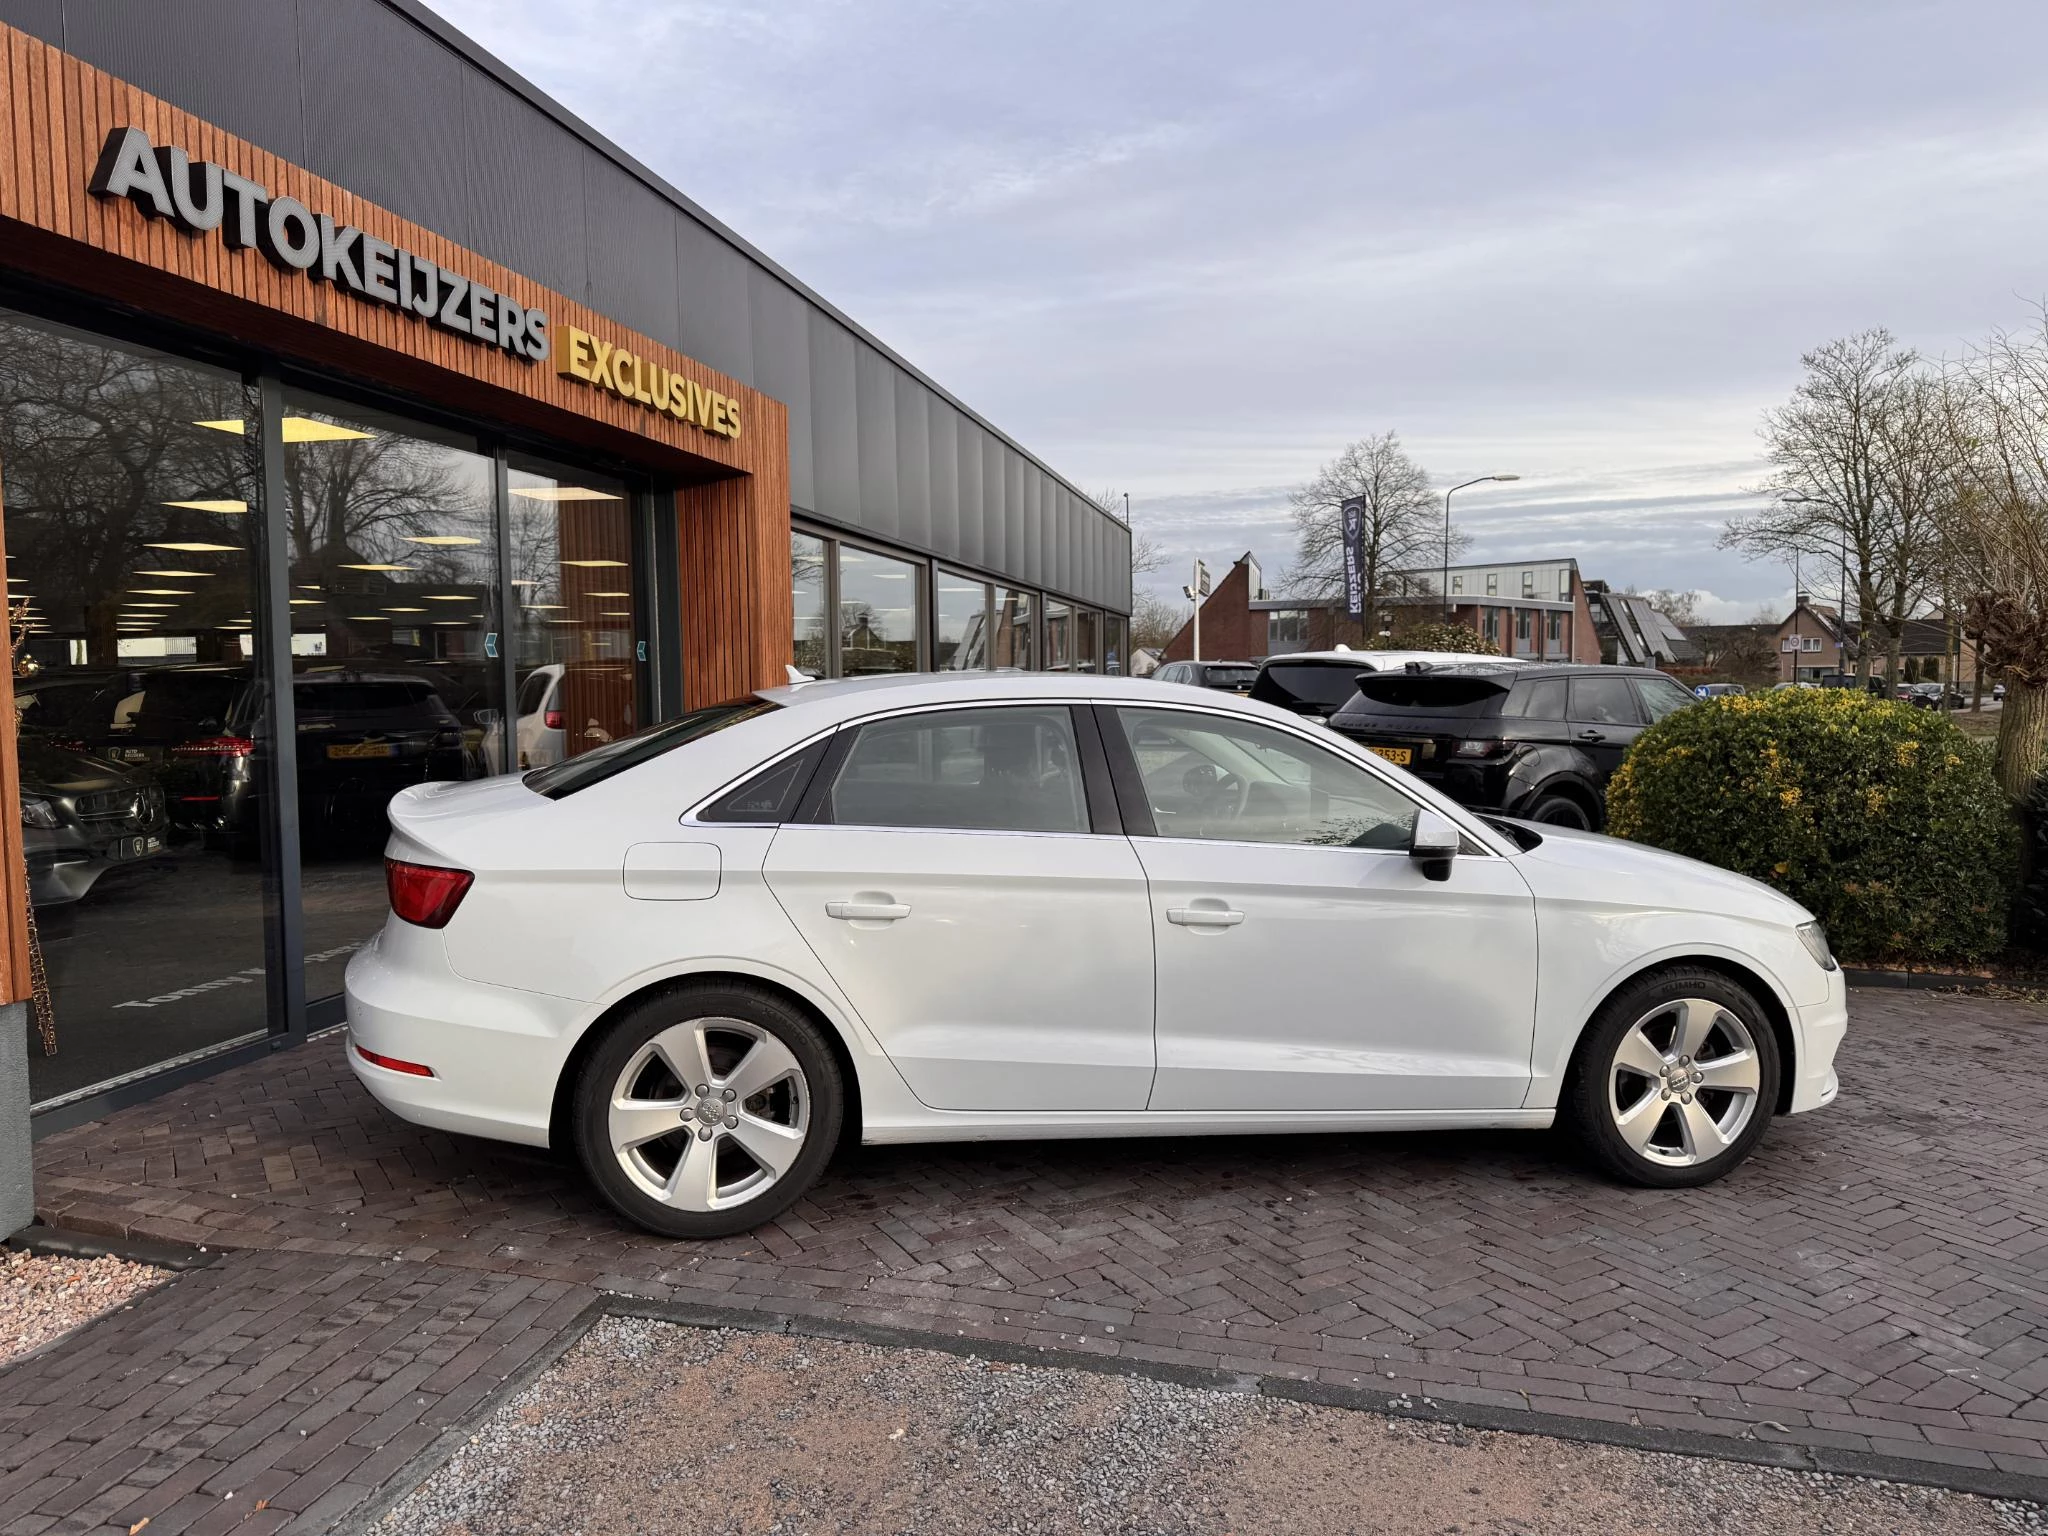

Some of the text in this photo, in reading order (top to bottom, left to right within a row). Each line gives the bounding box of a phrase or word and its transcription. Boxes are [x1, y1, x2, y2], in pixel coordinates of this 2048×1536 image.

[105, 125, 742, 440] AUTOKEIJZERS EXCLUSIVES
[1371, 748, 1407, 762] -353-S
[1662, 981, 1706, 993] KUMHO
[762, 1007, 808, 1046] KUMHO
